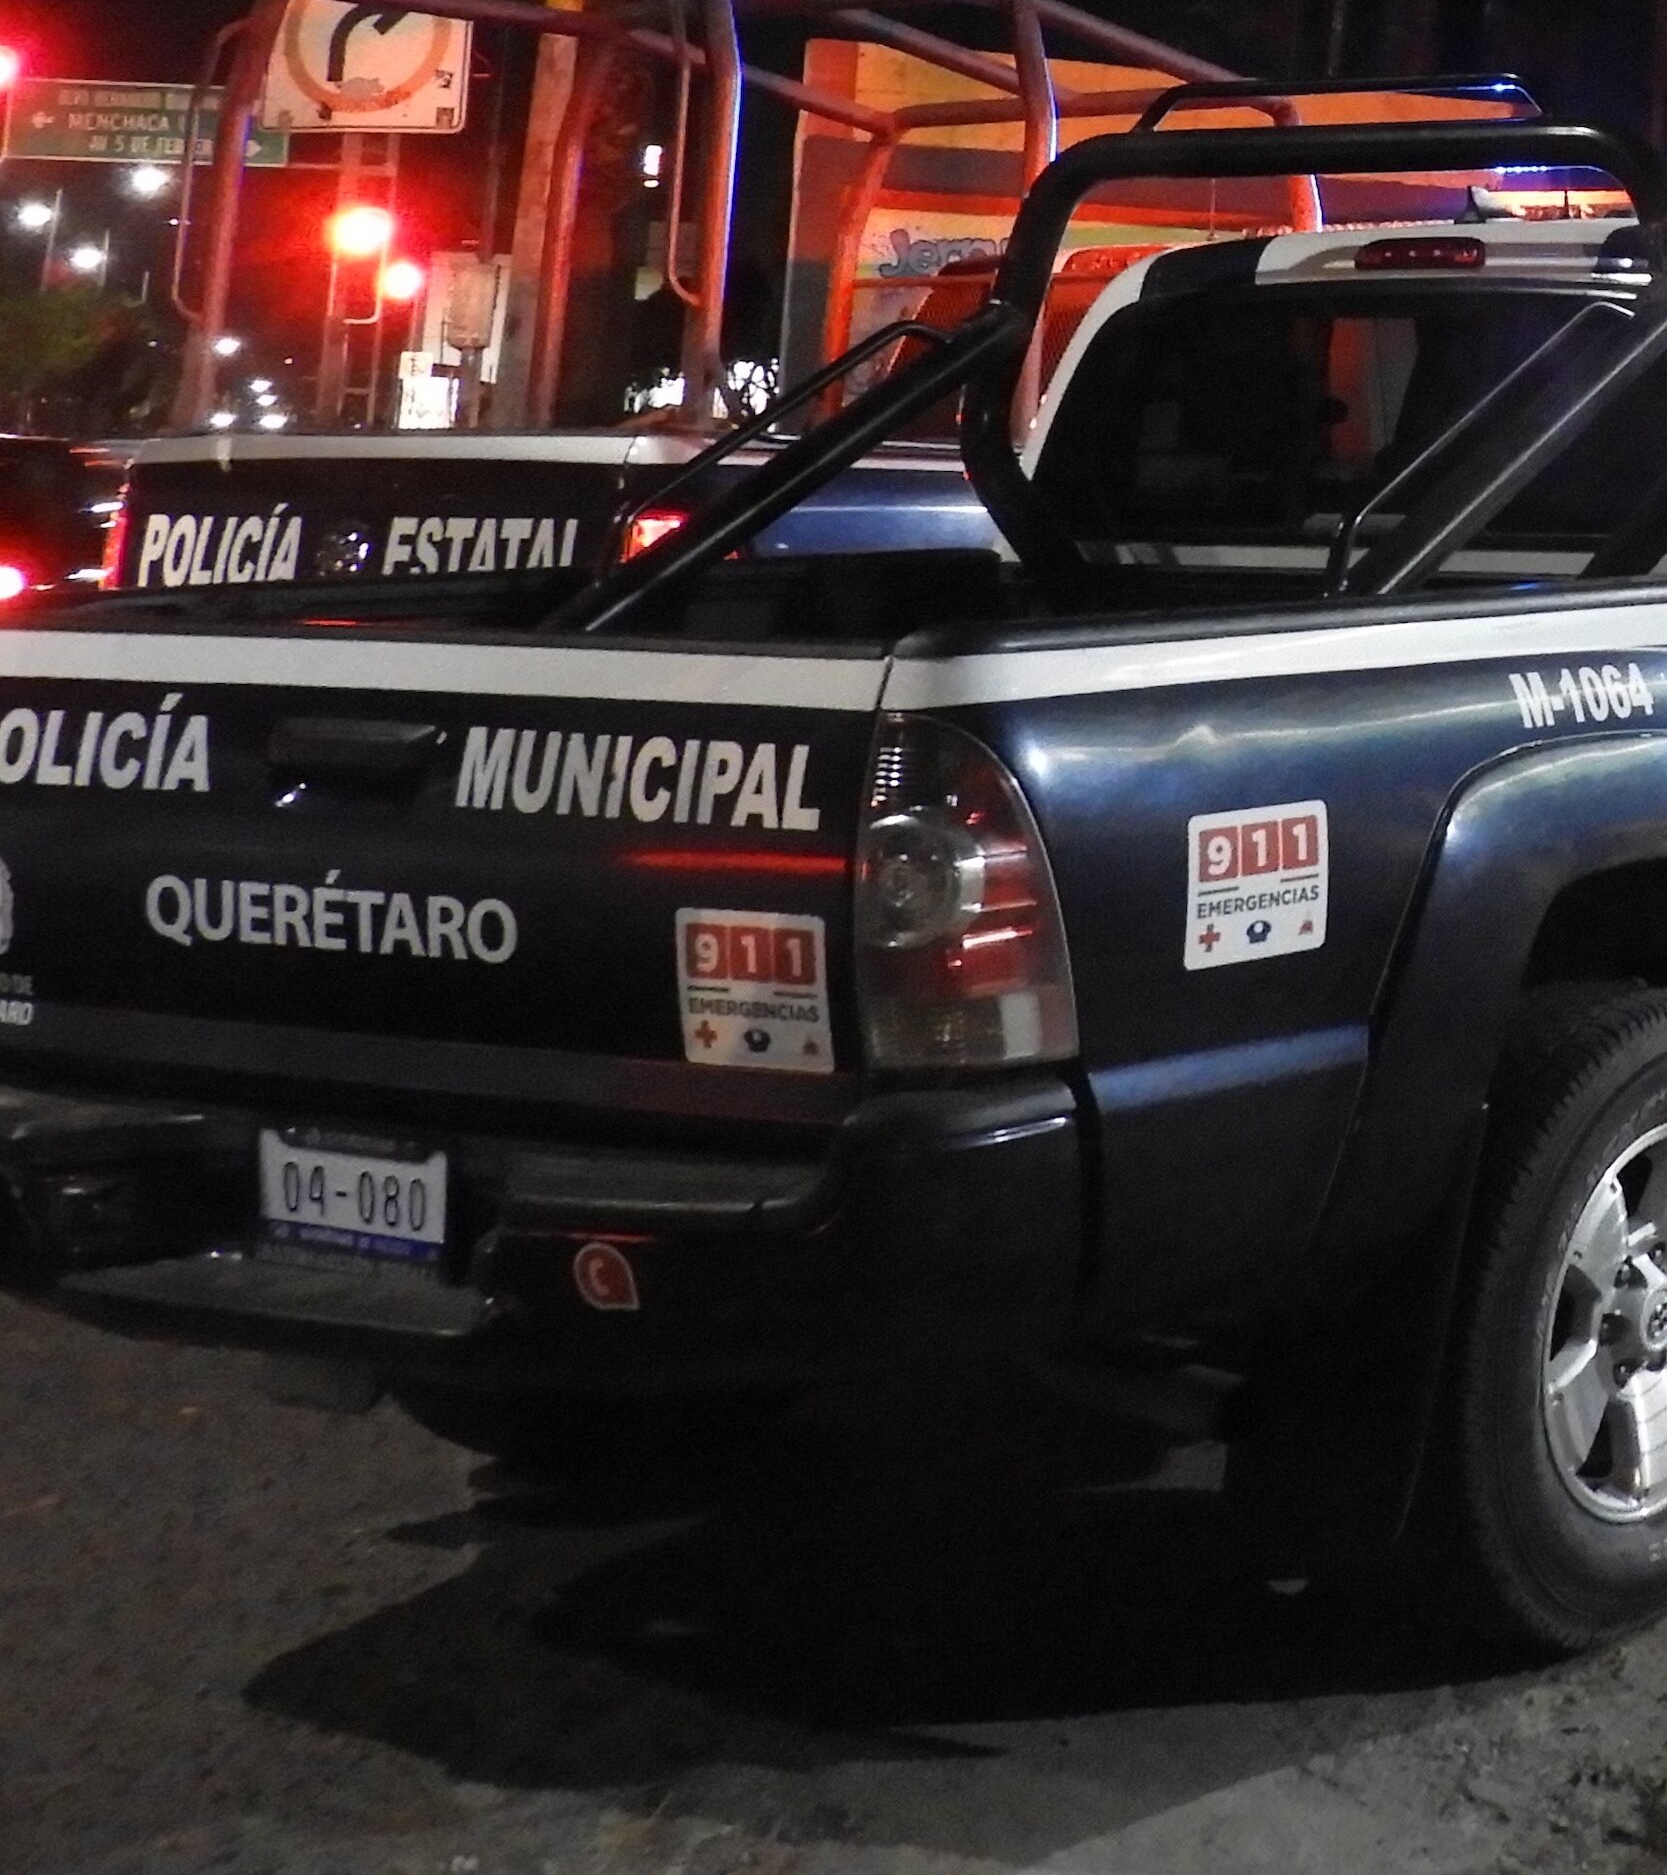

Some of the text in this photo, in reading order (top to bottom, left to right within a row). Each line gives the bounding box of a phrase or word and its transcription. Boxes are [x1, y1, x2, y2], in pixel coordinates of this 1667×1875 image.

[138, 502, 302, 588] POLICÍA
[1508, 662, 1655, 729] M-1064
[0, 692, 822, 831] OLICÍA MUNICIPAL
[1208, 823, 1308, 876] 911
[145, 870, 518, 963] QUERÉTARO
[1197, 884, 1320, 920] EMERGENCIAS
[694, 932, 803, 977] 911
[688, 997, 820, 1023] EMERGENCIAS
